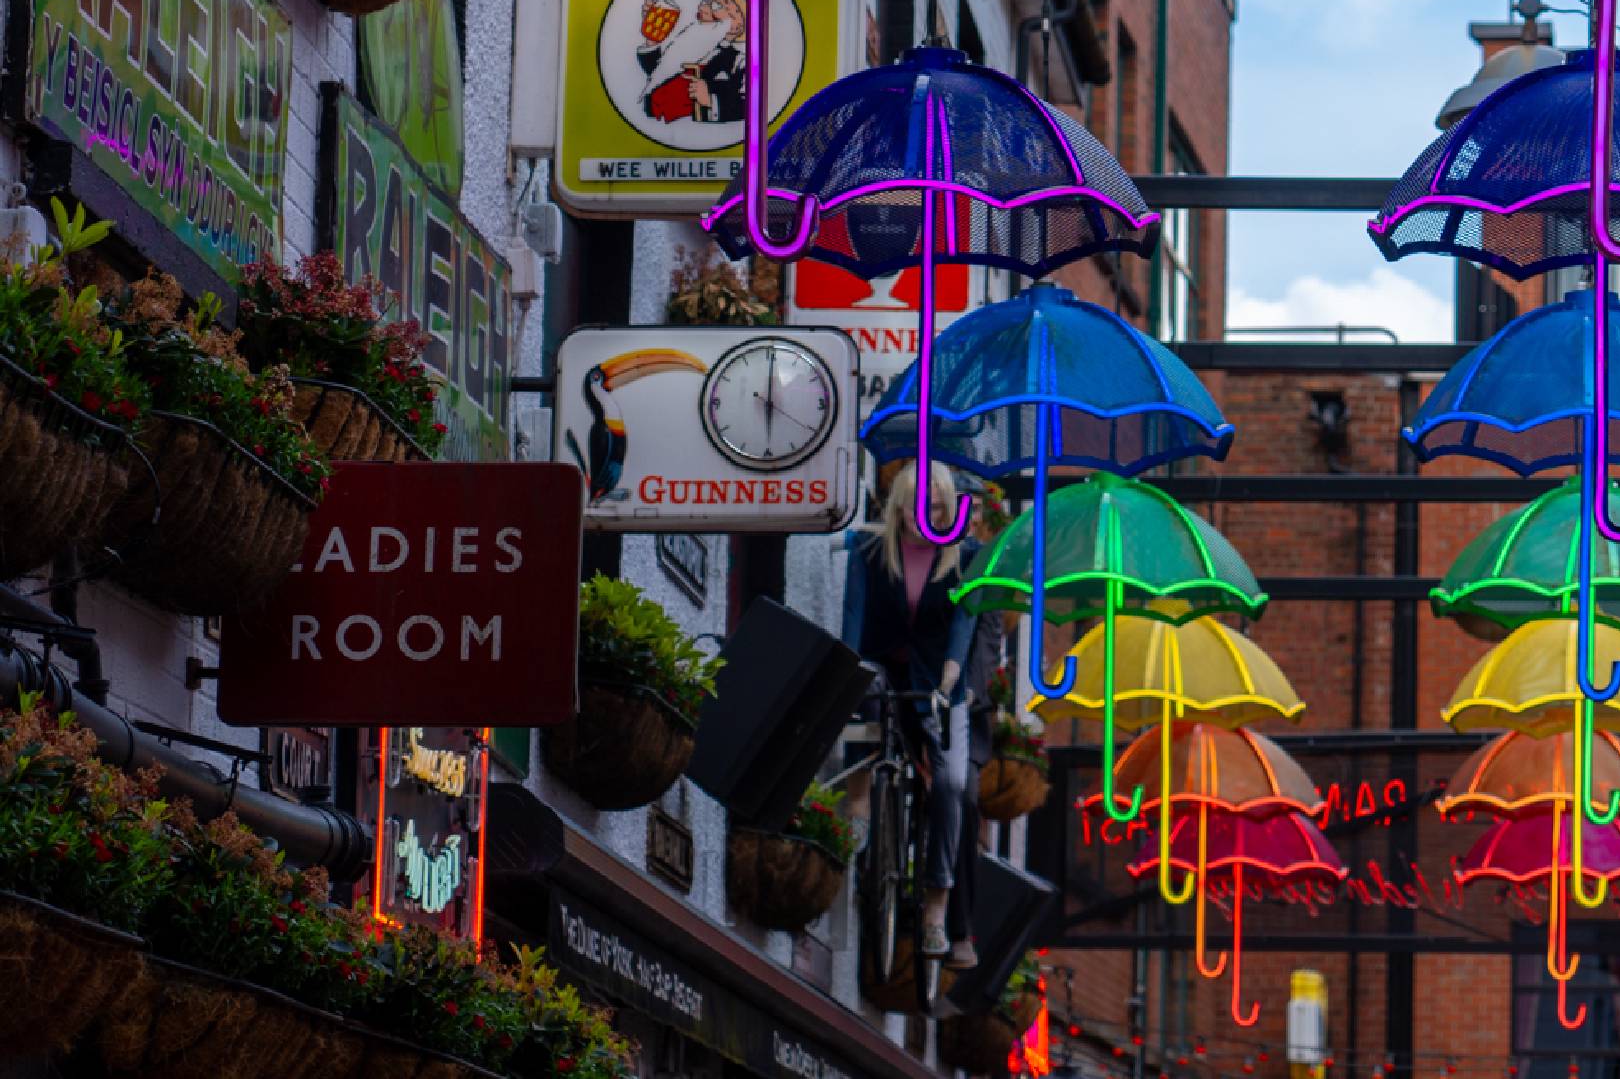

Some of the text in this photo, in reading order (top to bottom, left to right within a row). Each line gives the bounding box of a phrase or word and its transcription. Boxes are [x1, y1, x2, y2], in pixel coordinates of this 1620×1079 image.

[600, 161, 642, 178] WEE
[653, 161, 719, 178] WILLIE
[344, 122, 510, 434] RALEIGH
[638, 475, 828, 505] GUINNESS
[290, 526, 524, 573] ADIES
[290, 614, 503, 661] ROOM
